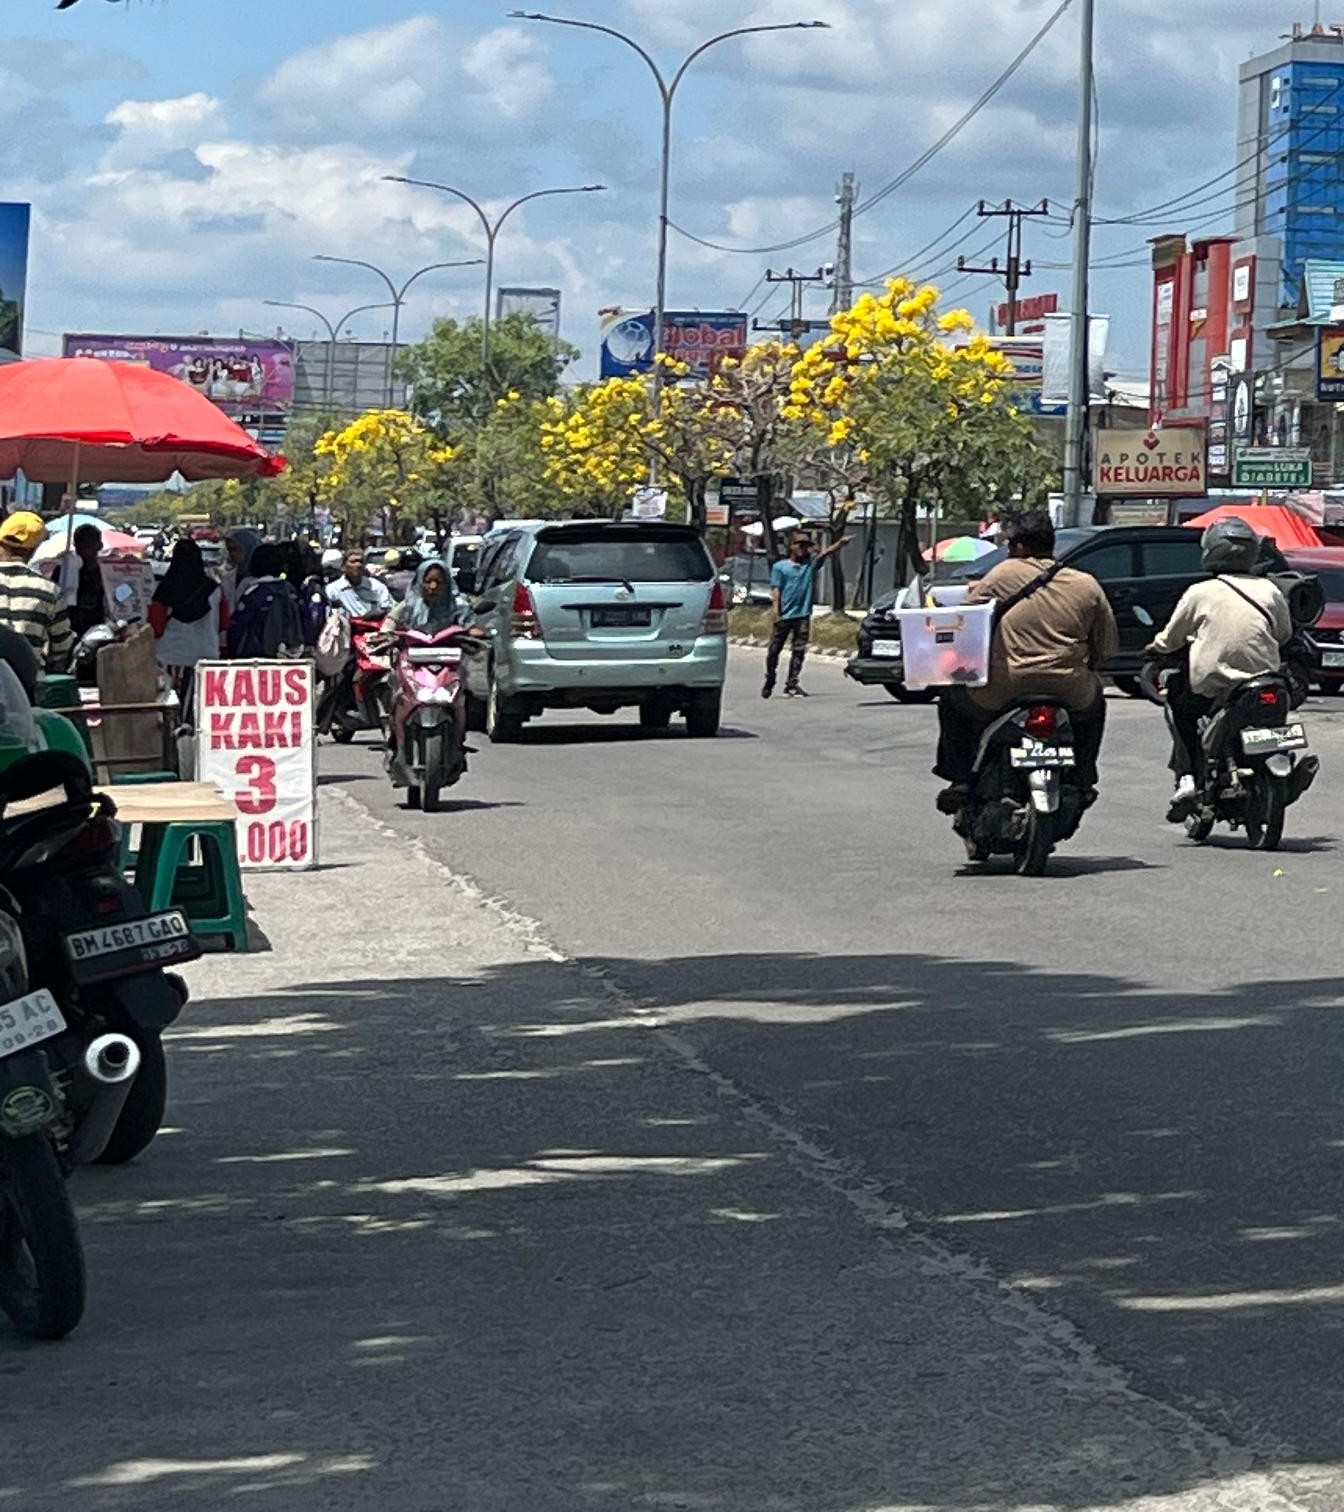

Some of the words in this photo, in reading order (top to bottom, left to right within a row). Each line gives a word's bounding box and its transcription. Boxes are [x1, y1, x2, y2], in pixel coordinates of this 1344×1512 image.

[1099, 465, 1200, 483] KELUARGA
[1101, 451, 1201, 465] APOTEK
[205, 668, 308, 707] KAUS
[210, 711, 303, 750] KAKI
[234, 754, 277, 815] 3
[72, 934, 99, 957] BM
[102, 925, 144, 948] 4687
[22, 994, 52, 1022] AC
